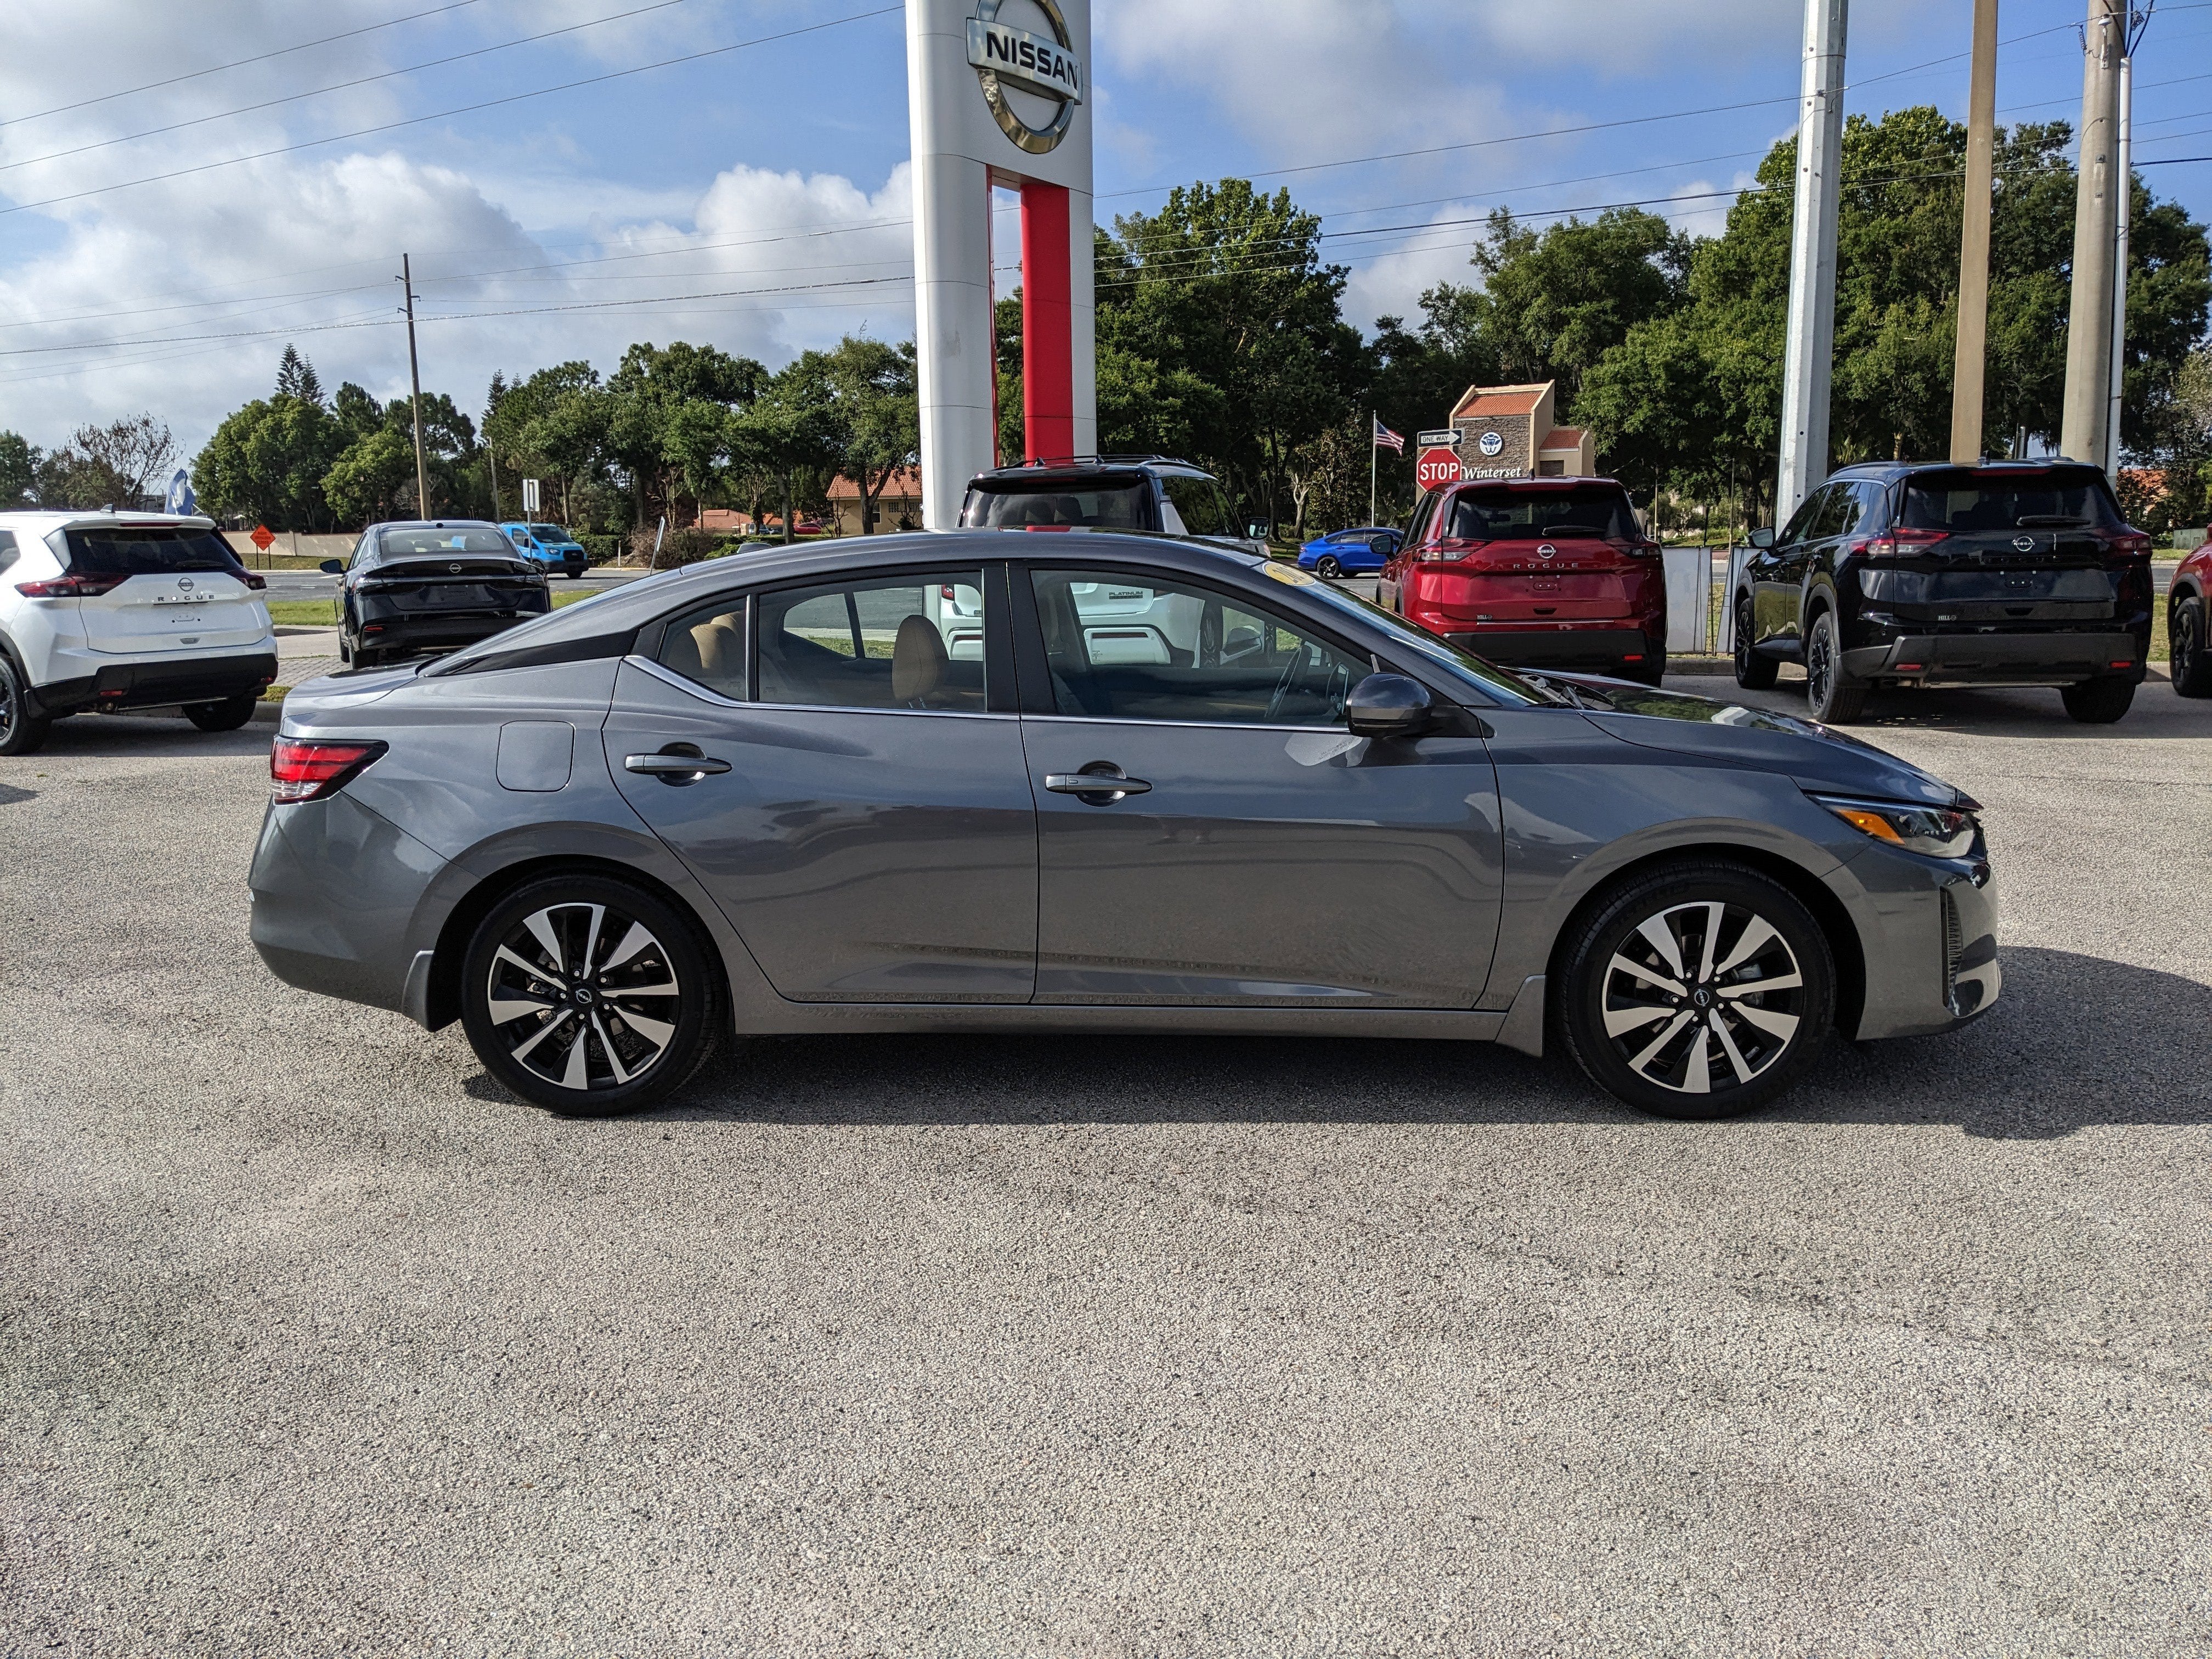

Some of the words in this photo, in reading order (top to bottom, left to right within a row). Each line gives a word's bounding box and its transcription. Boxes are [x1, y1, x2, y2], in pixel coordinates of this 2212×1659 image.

[986, 31, 1079, 91] NISSAN
[1420, 462, 1458, 481] STOP
[1462, 466, 1522, 479] Winterset
